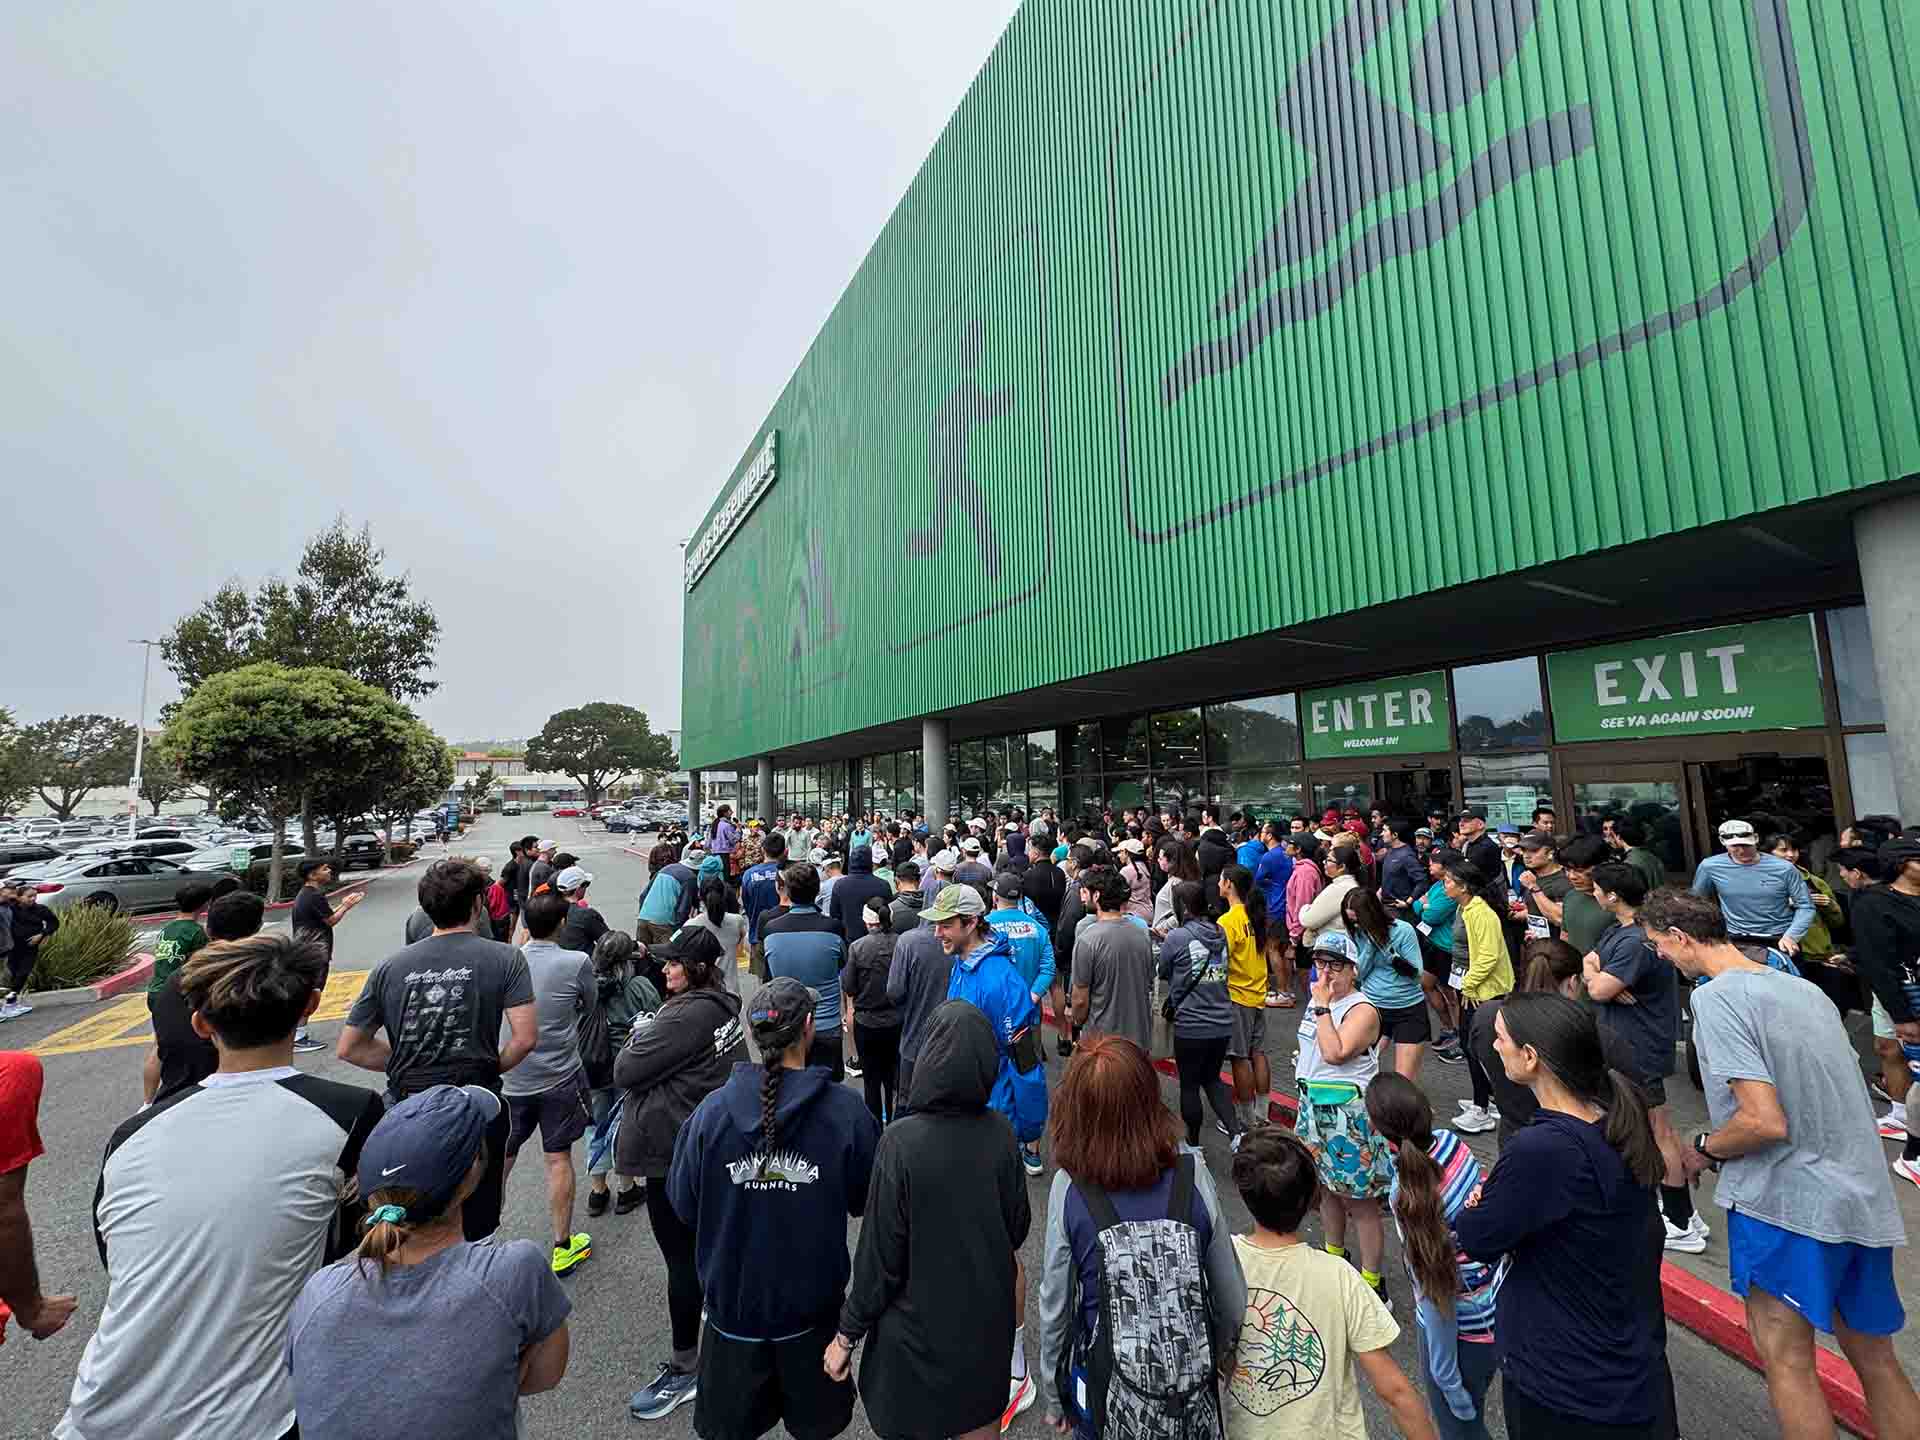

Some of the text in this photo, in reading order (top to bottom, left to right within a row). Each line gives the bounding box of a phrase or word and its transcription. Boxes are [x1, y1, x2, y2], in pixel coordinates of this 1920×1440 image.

[1594, 644, 1745, 706] EXIT
[1311, 688, 1433, 733] ENTER
[1600, 706, 1755, 729] SEE YA AGAIN SOON!
[1343, 735, 1400, 748] WELCOME IN!
[725, 1156, 820, 1179] TAMALPA
[744, 1180, 798, 1192] RUNNERS
